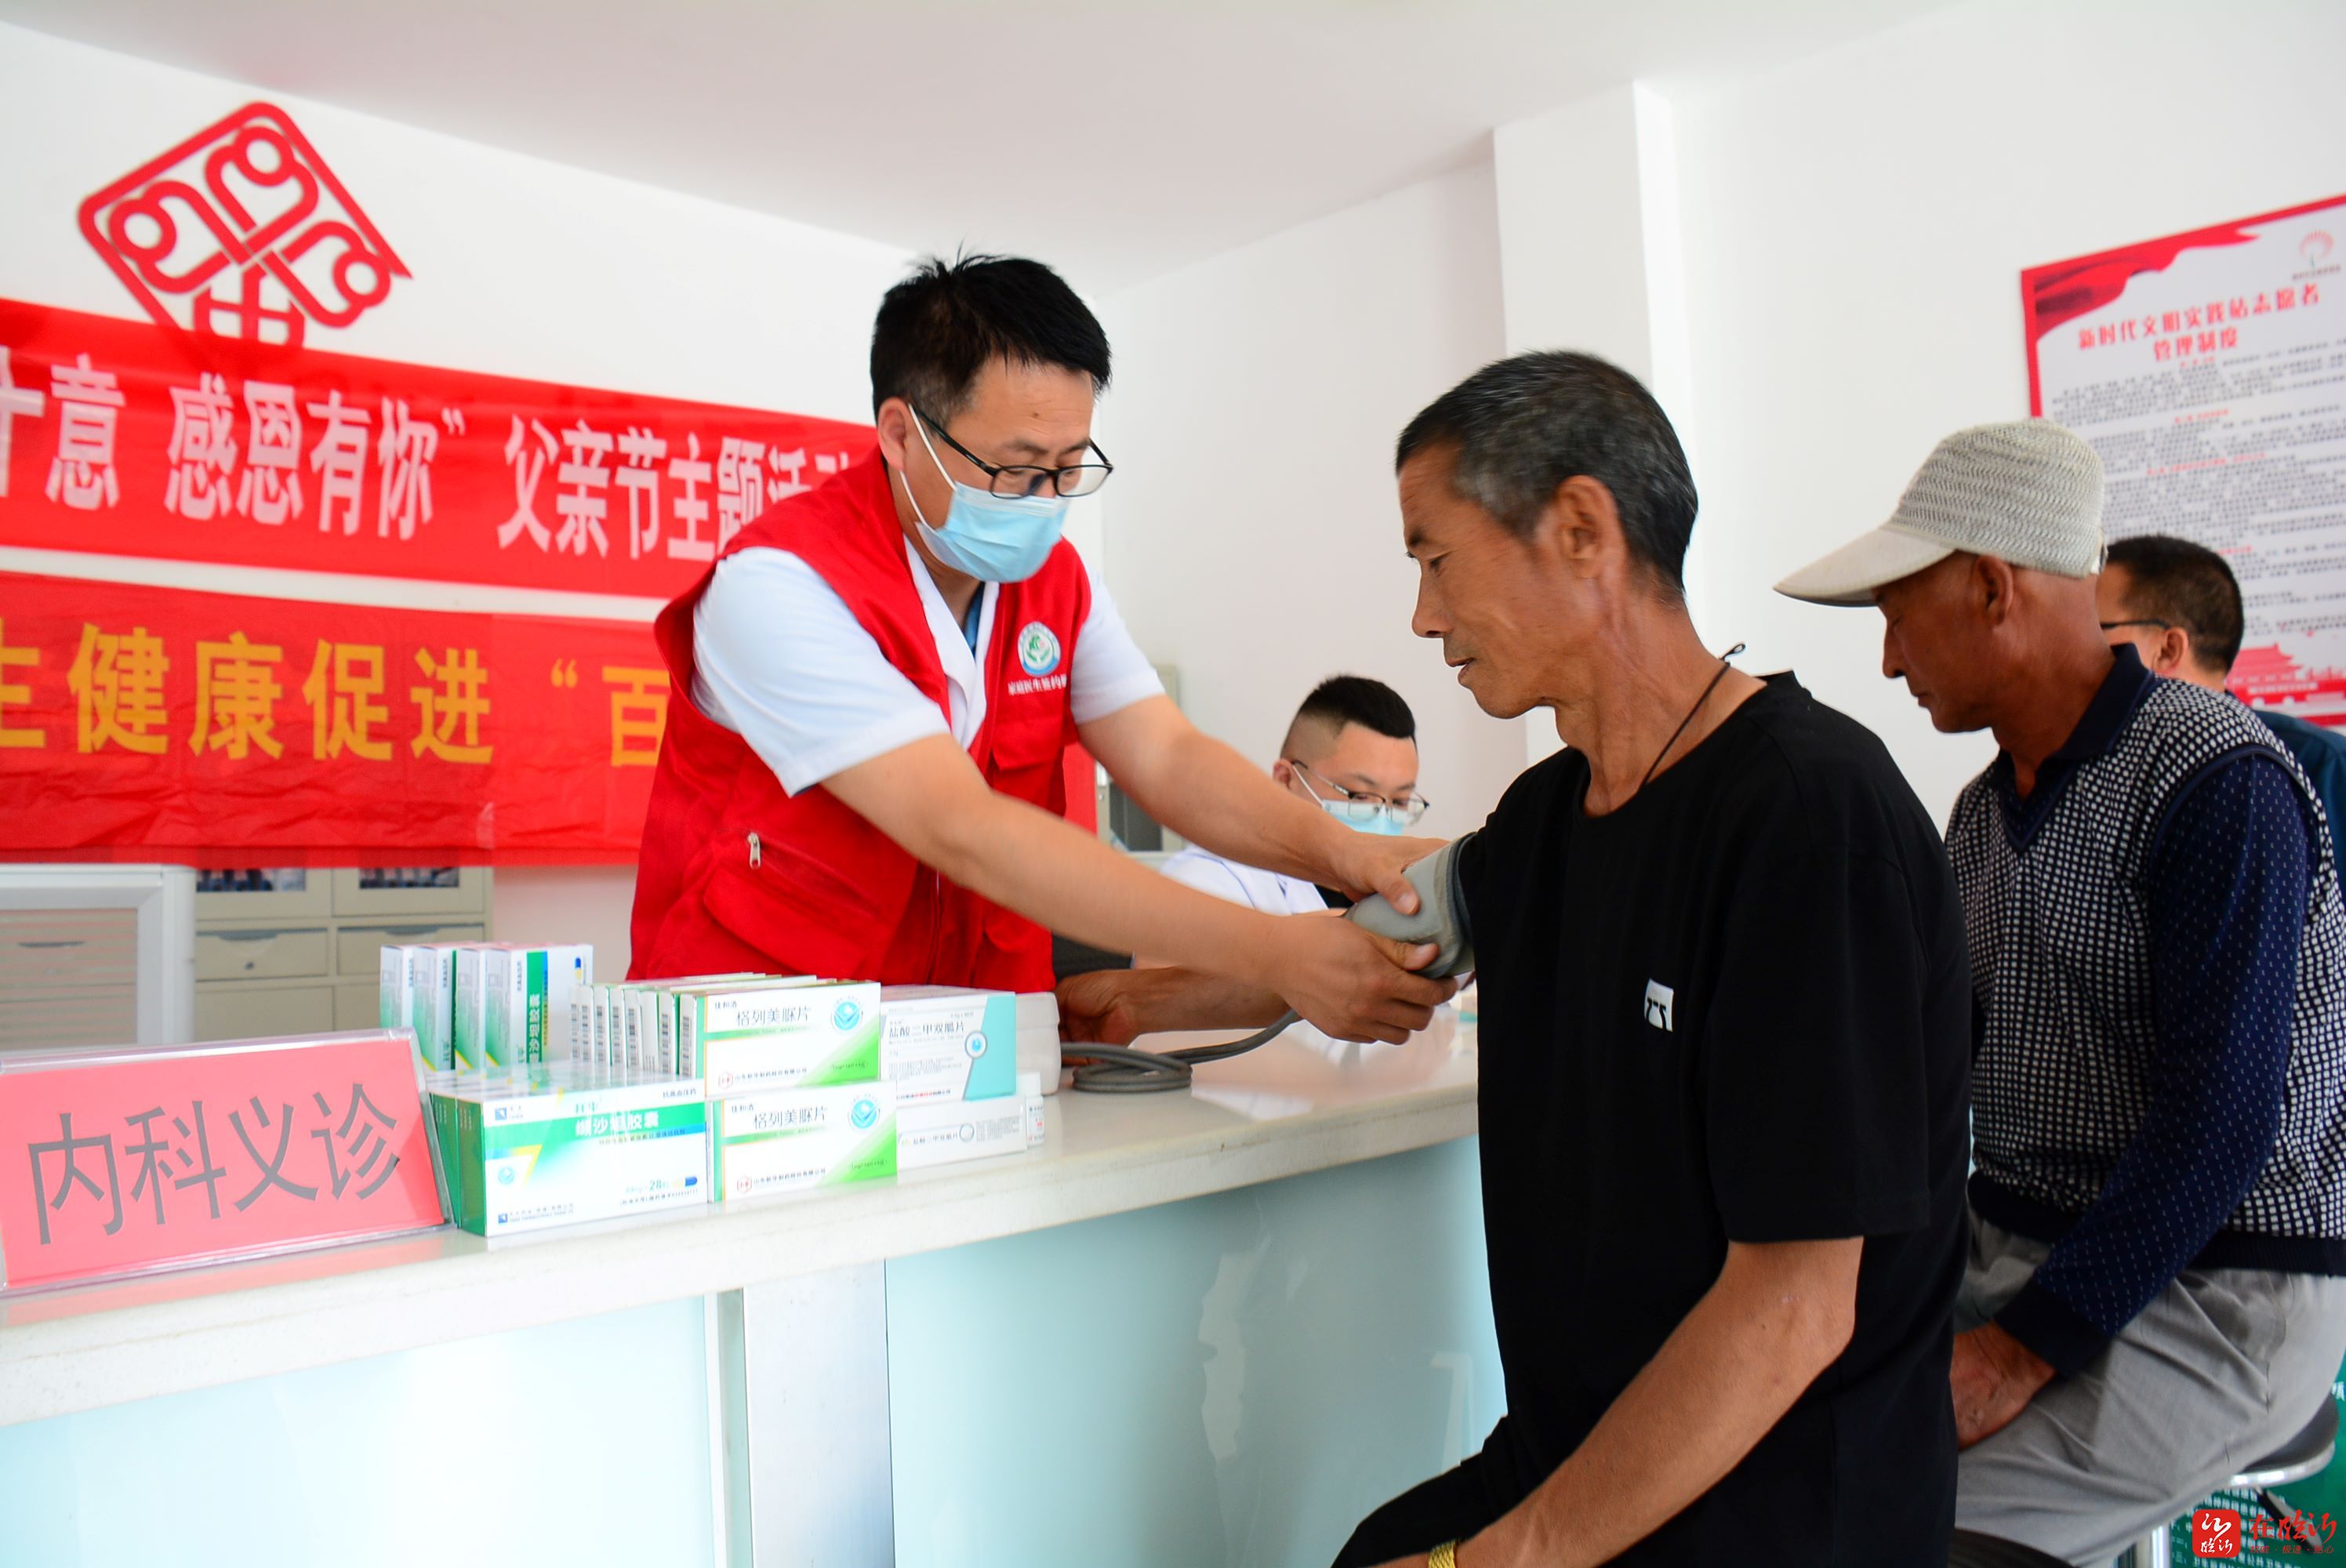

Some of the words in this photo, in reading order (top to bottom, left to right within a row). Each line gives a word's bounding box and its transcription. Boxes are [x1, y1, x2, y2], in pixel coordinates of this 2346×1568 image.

[2154, 326, 2237, 361] 管理制度
[28, 1083, 400, 1245] 内科义诊
